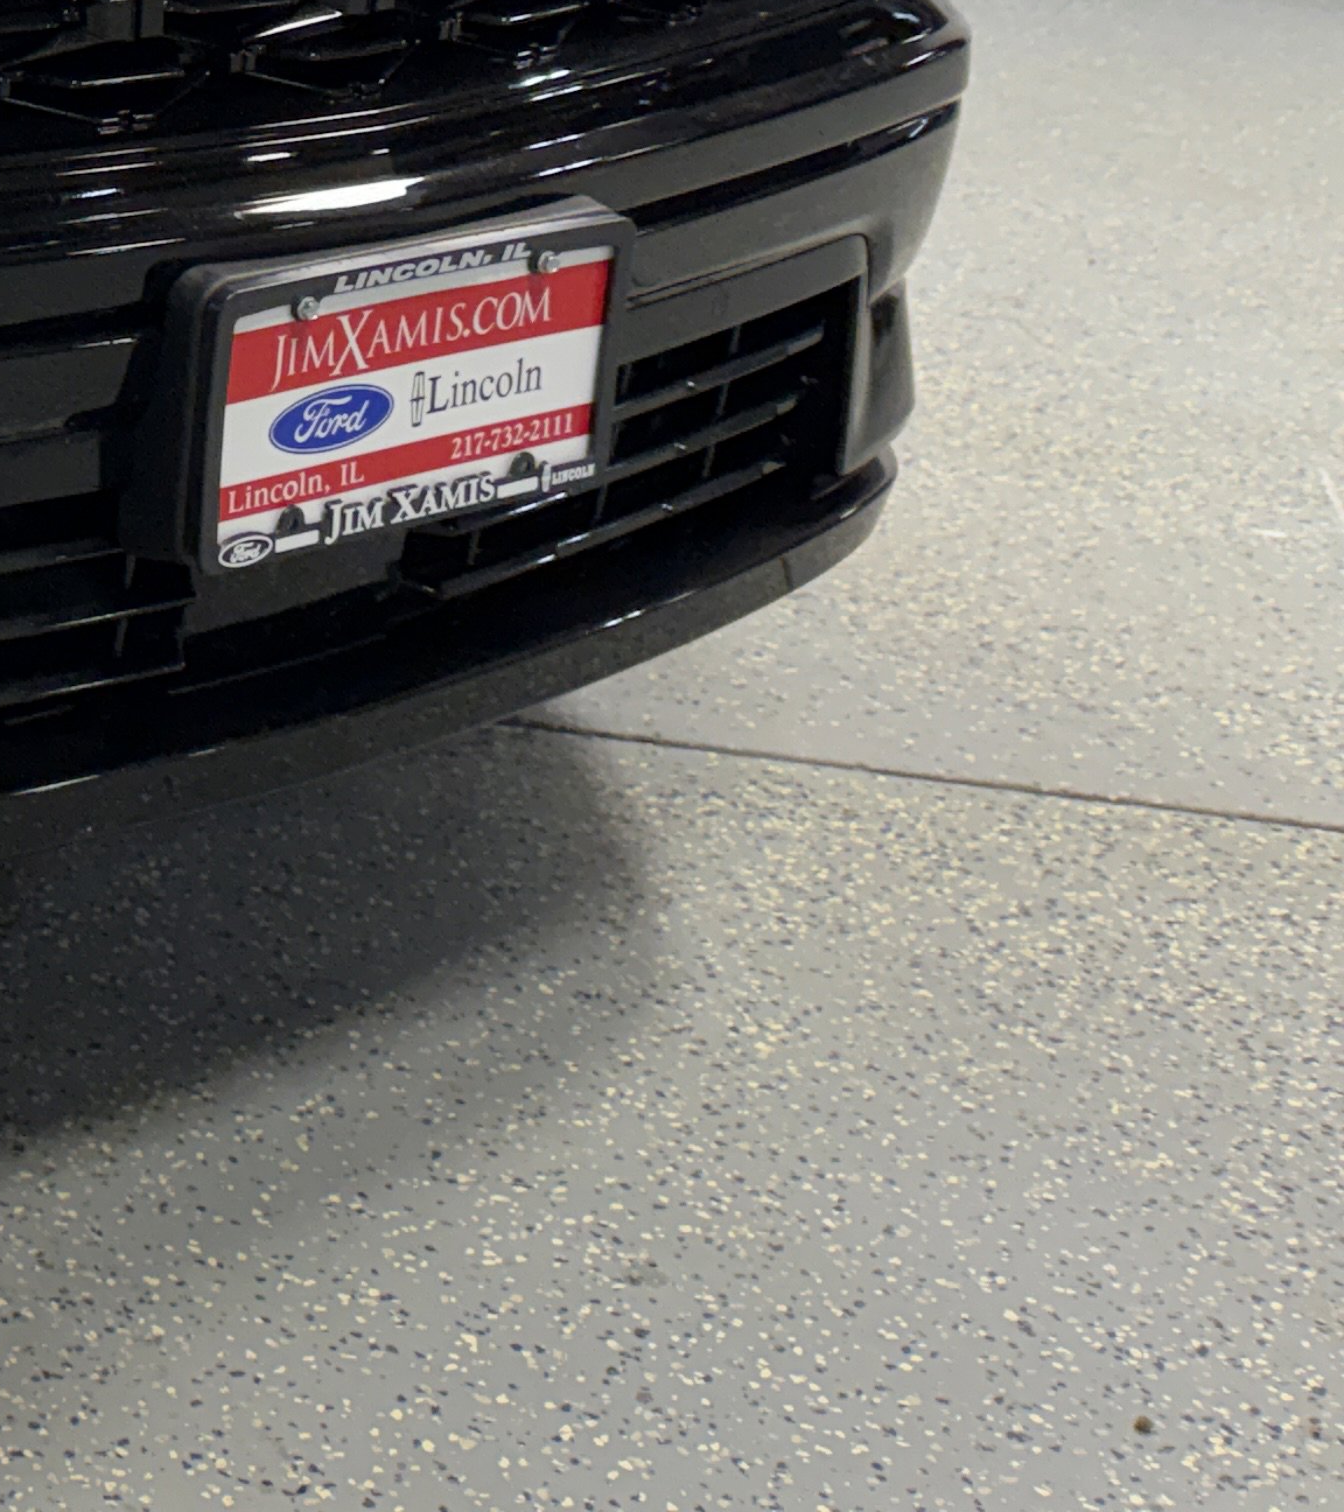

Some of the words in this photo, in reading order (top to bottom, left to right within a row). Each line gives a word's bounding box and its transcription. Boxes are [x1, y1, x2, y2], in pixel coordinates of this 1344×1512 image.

[333, 248, 493, 294] LINCOLN,
[501, 241, 532, 262] IL
[271, 286, 552, 392] JIMXAMIS.COM
[426, 357, 543, 415] Lincoln
[293, 395, 368, 444] Ford
[450, 413, 574, 461] 217-732-2111
[228, 471, 331, 514] Lincoln,
[341, 461, 366, 487] IL
[324, 500, 385, 546] JIM
[391, 475, 496, 525] XAMIS
